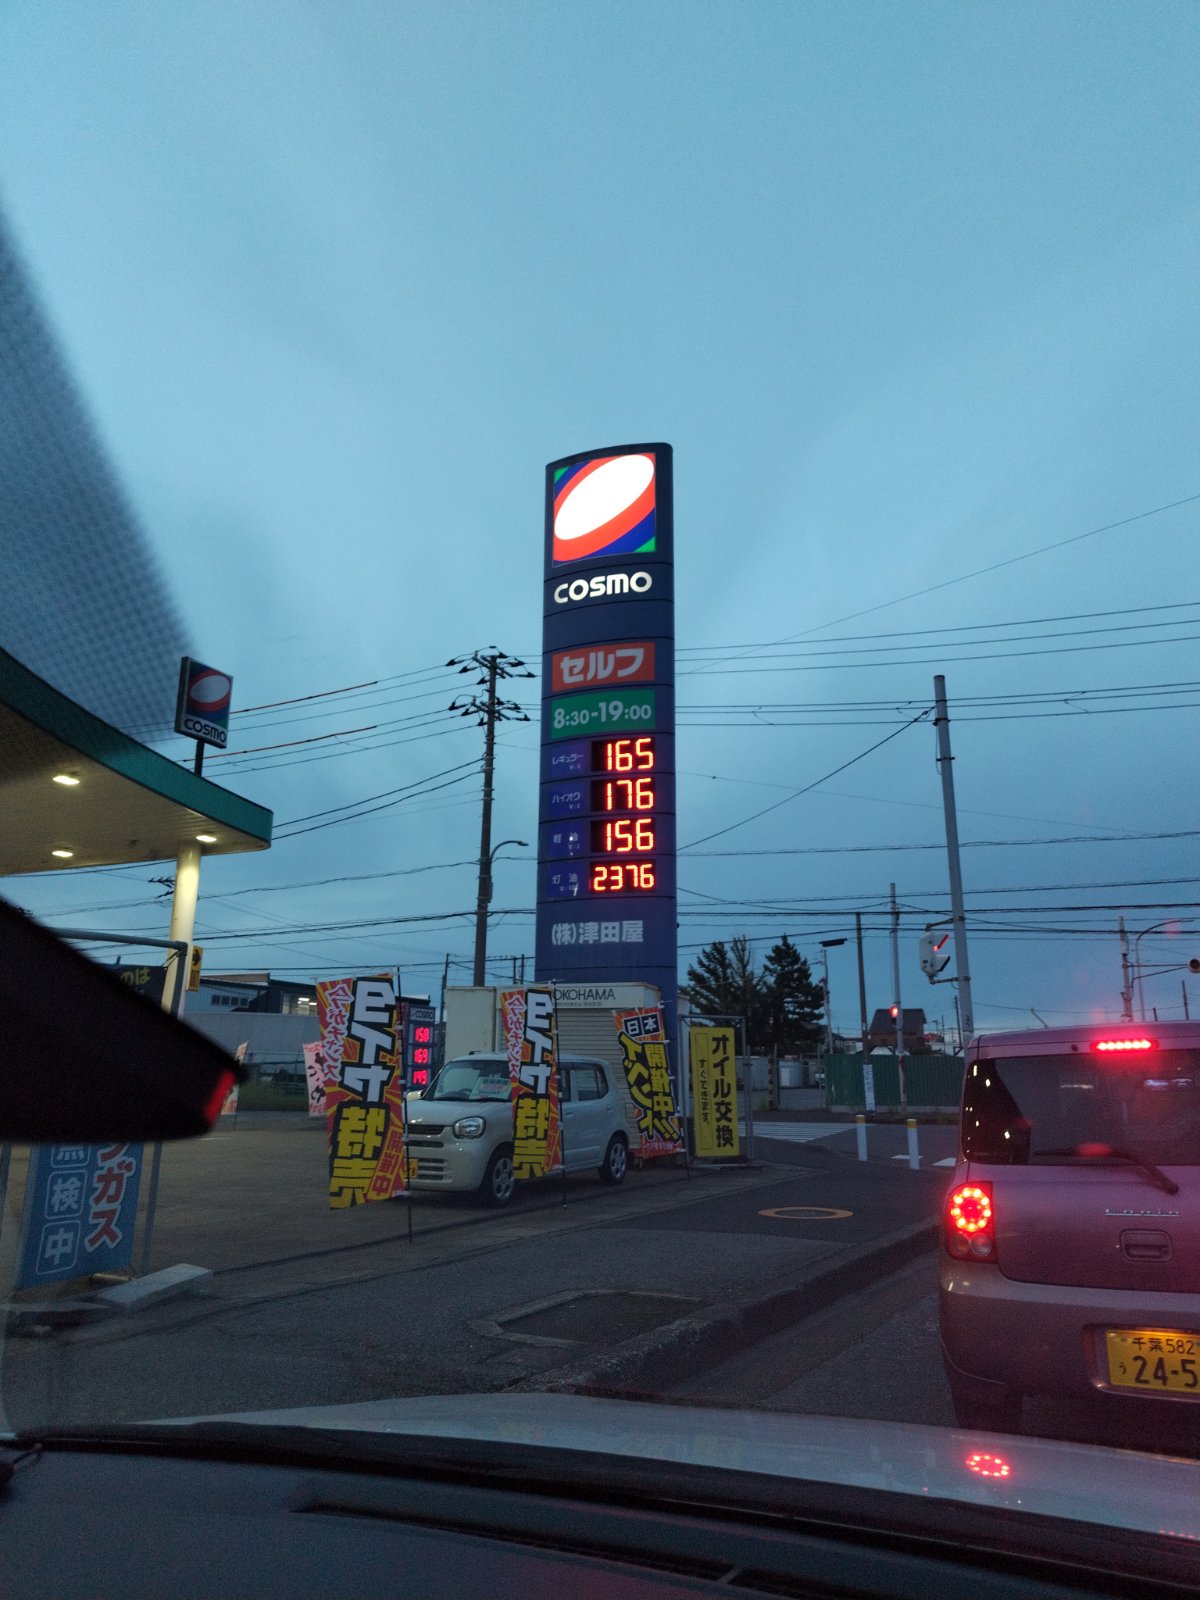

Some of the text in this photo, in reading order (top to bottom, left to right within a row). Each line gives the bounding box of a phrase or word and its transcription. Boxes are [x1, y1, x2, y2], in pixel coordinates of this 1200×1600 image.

[553, 571, 653, 604] COSMO
[560, 647, 645, 684] セルフ
[553, 700, 652, 729] 8:30-19:00
[184, 718, 227, 743] COSMO
[552, 753, 584, 765] レギュラー
[606, 737, 655, 771] 165
[551, 791, 581, 804] ハイオク
[606, 778, 655, 811] 176
[606, 818, 655, 852] 156
[592, 863, 655, 892] 2376
[551, 919, 644, 946] (株)津田屋
[553, 987, 616, 1001] OKOHAMA
[711, 1034, 734, 1148] オイル交換
